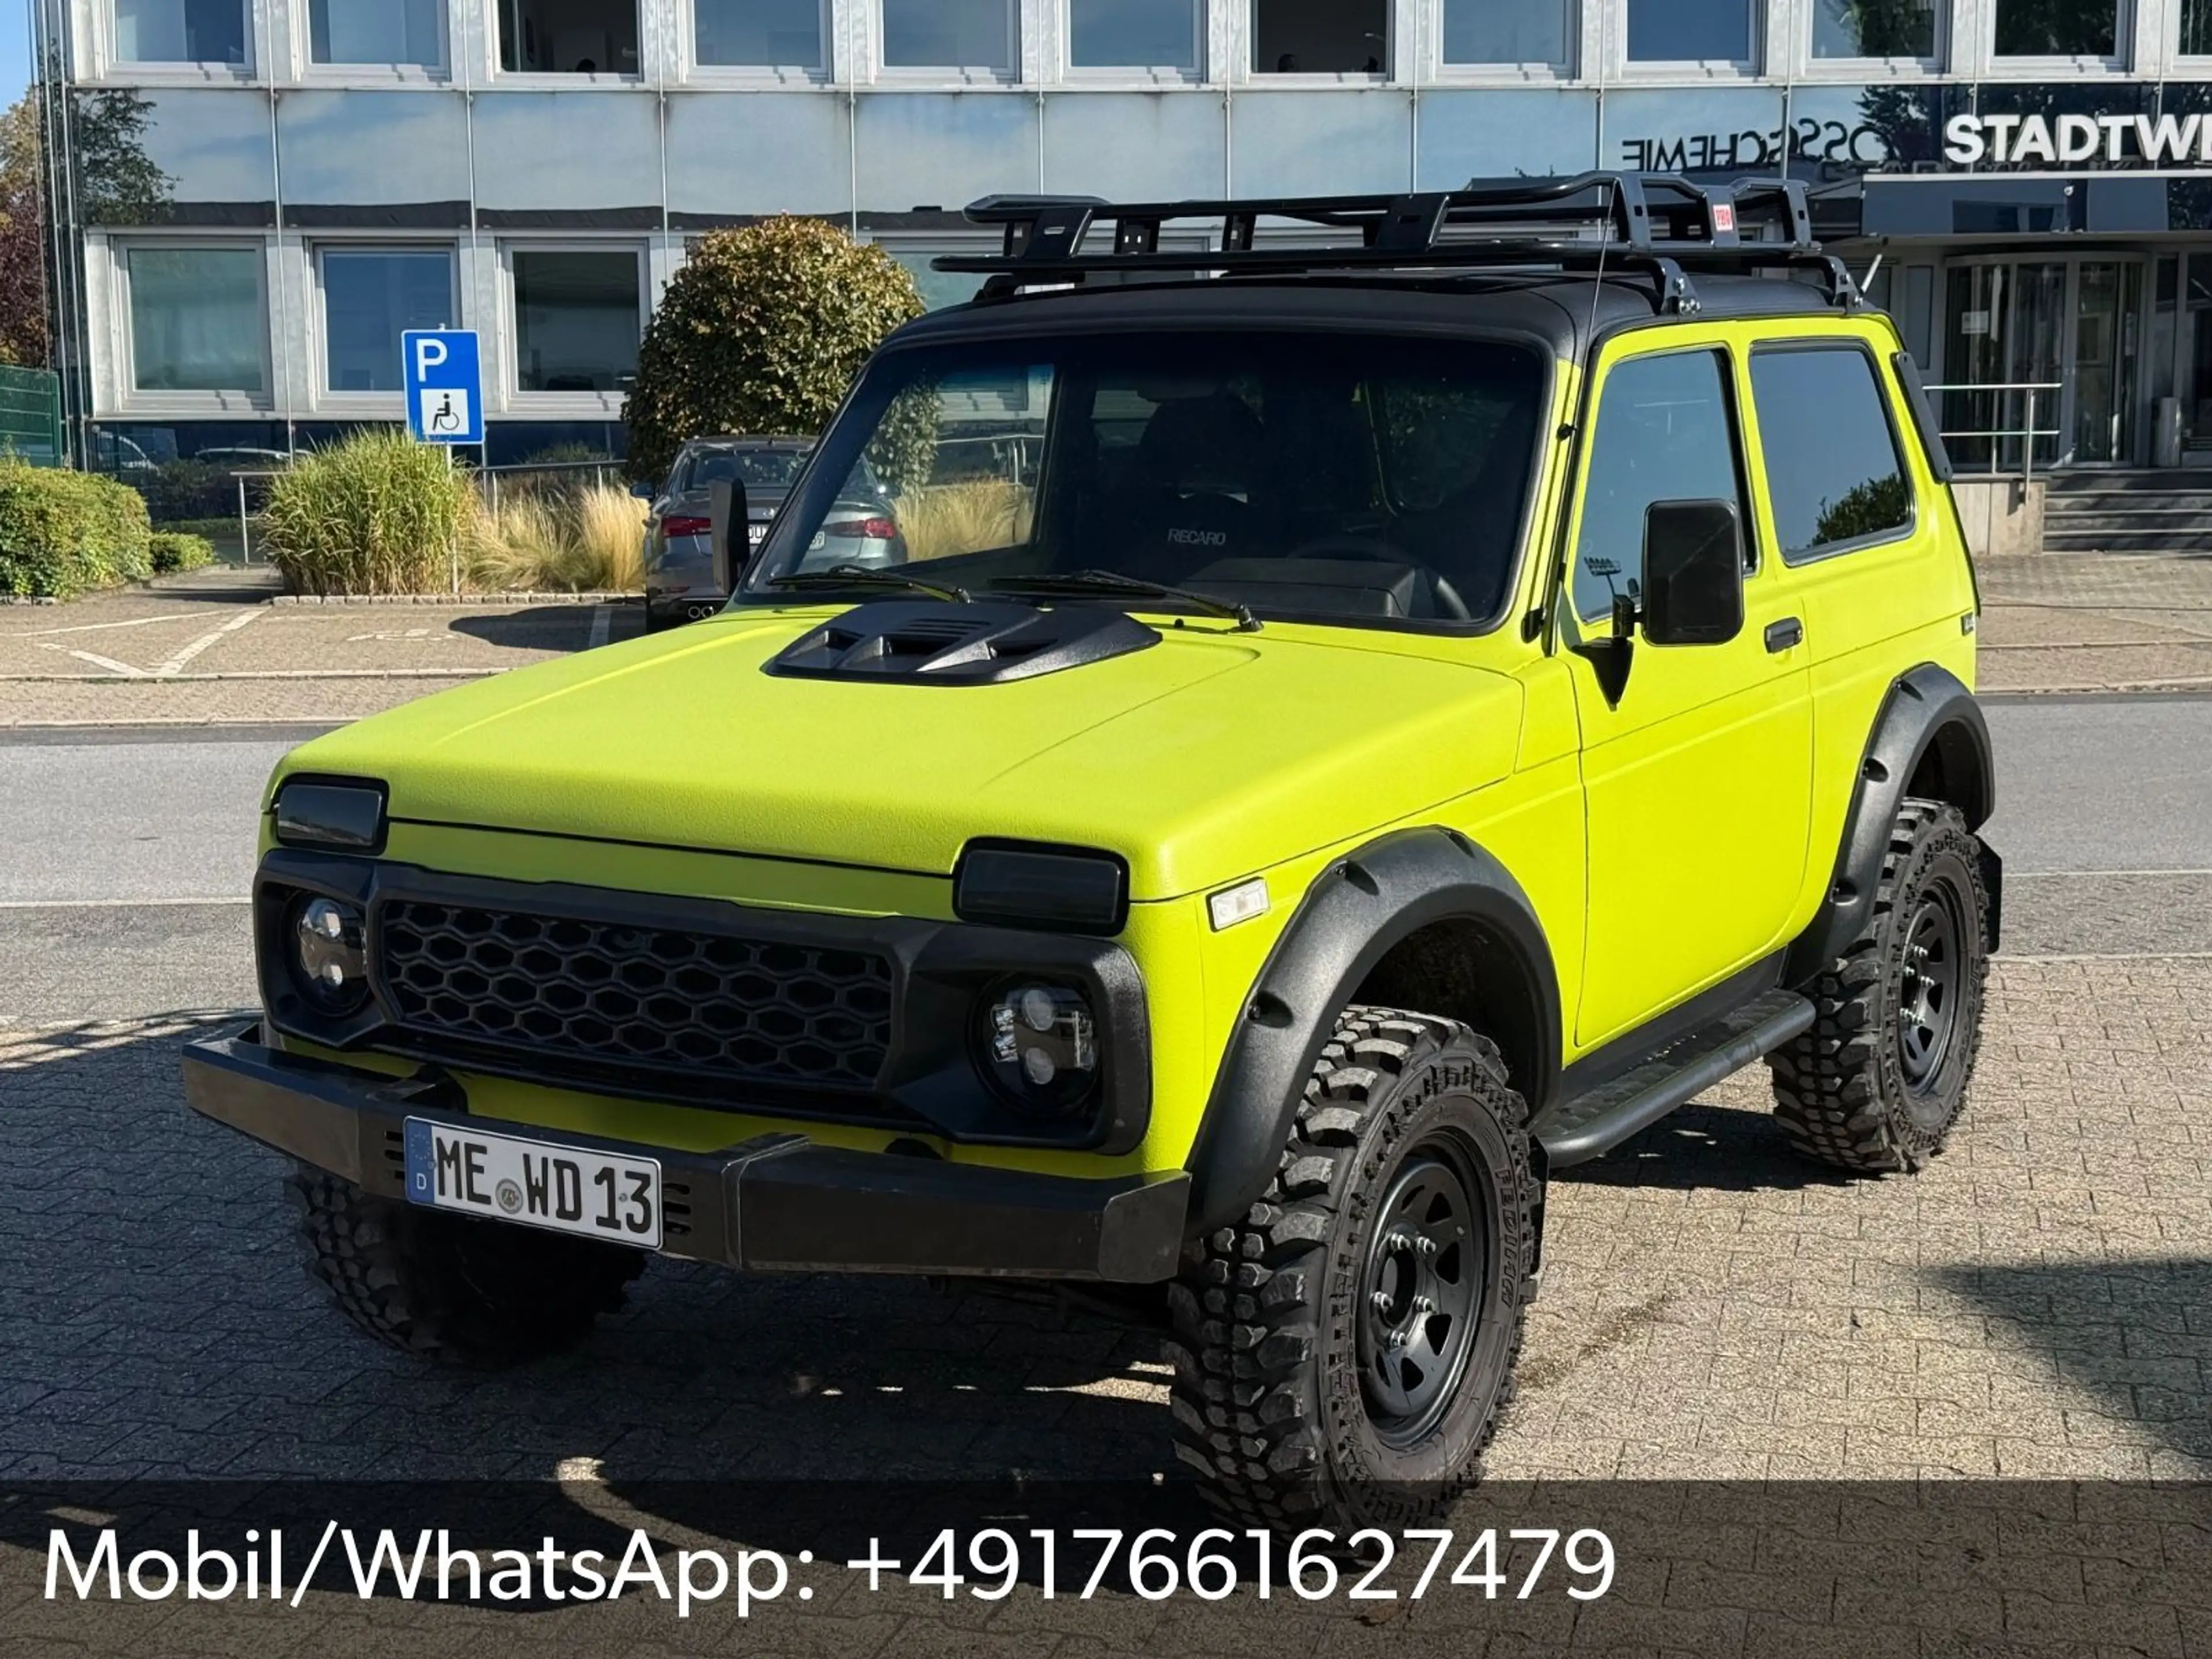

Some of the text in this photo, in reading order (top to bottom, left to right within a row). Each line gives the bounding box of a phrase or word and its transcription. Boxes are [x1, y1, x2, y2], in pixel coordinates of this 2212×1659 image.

[416, 338, 448, 382] P
[1168, 528, 1226, 545] RECARO
[416, 1173, 427, 1190] D
[436, 1137, 652, 1234] ME WD 13
